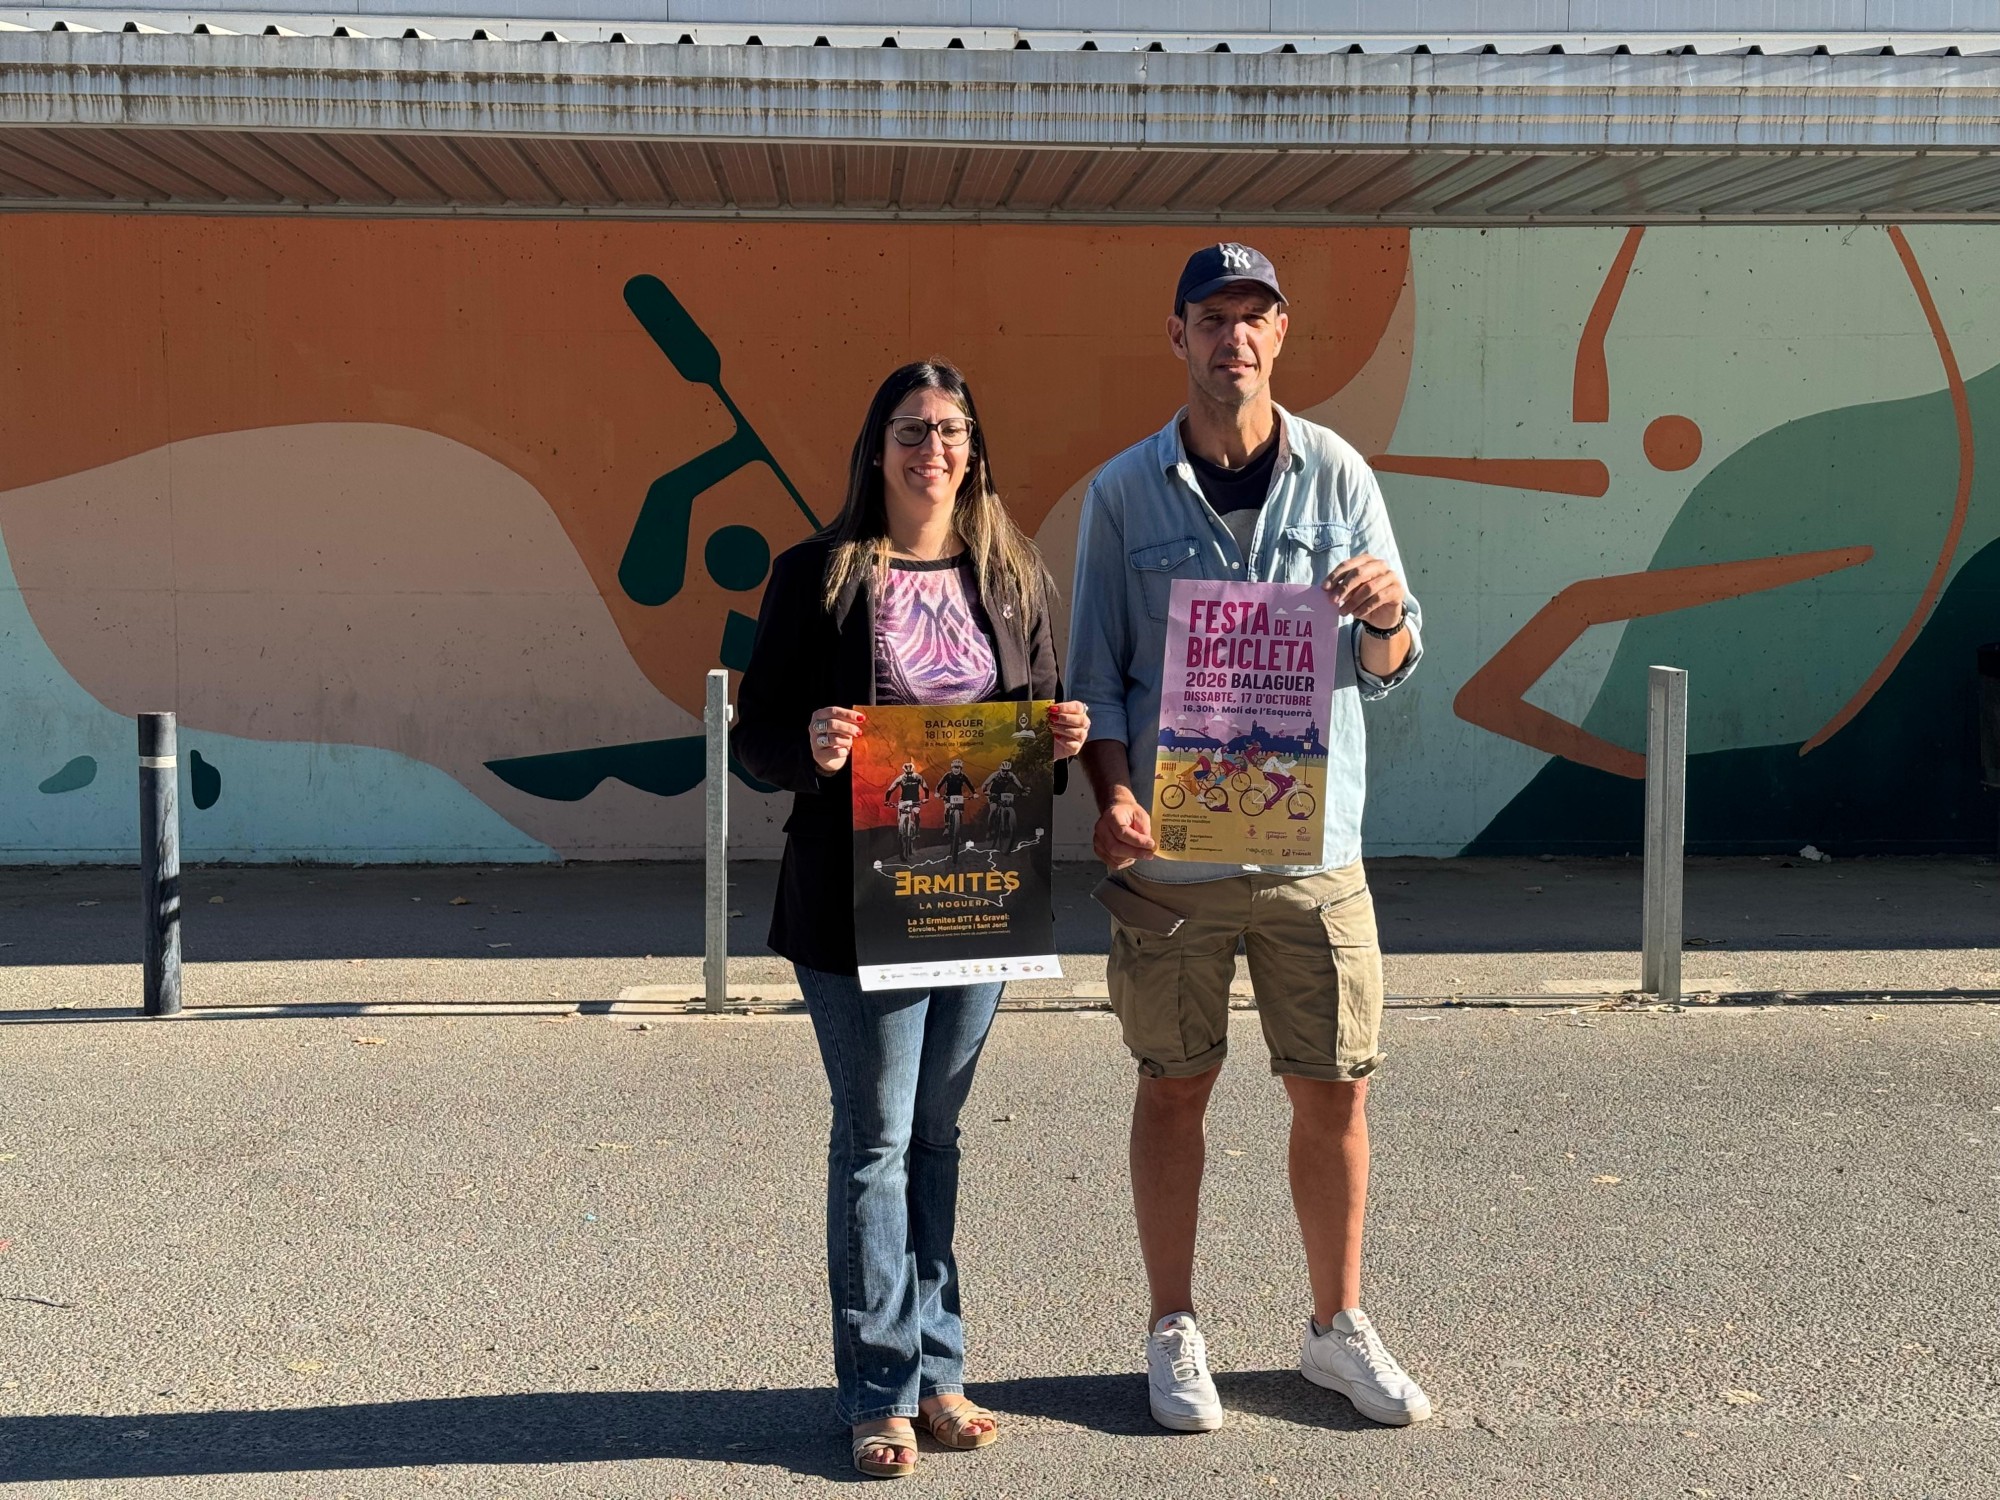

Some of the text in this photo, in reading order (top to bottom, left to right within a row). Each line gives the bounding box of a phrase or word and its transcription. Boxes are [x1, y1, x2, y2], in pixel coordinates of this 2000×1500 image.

[1222, 247, 1252, 269] NY
[1189, 599, 1313, 638] FESTA DE LA
[1186, 636, 1315, 673] BICICLETA
[1185, 671, 1315, 692] 2026 BALAGUER
[1183, 690, 1312, 707] DISSABTE, 17 D'OCTUBRE
[1183, 704, 1215, 713] 16.30h
[1221, 705, 1243, 714] Molí
[1244, 706, 1258, 715] de
[925, 719, 983, 728] BALAGUER
[958, 729, 984, 738] 2026
[919, 899, 990, 910] LA NOGUERA
[907, 913, 1010, 926] La 3 Ermites BTT & Gravel:
[938, 924, 972, 932] Montalegre
[992, 921, 1008, 929] Jordi
